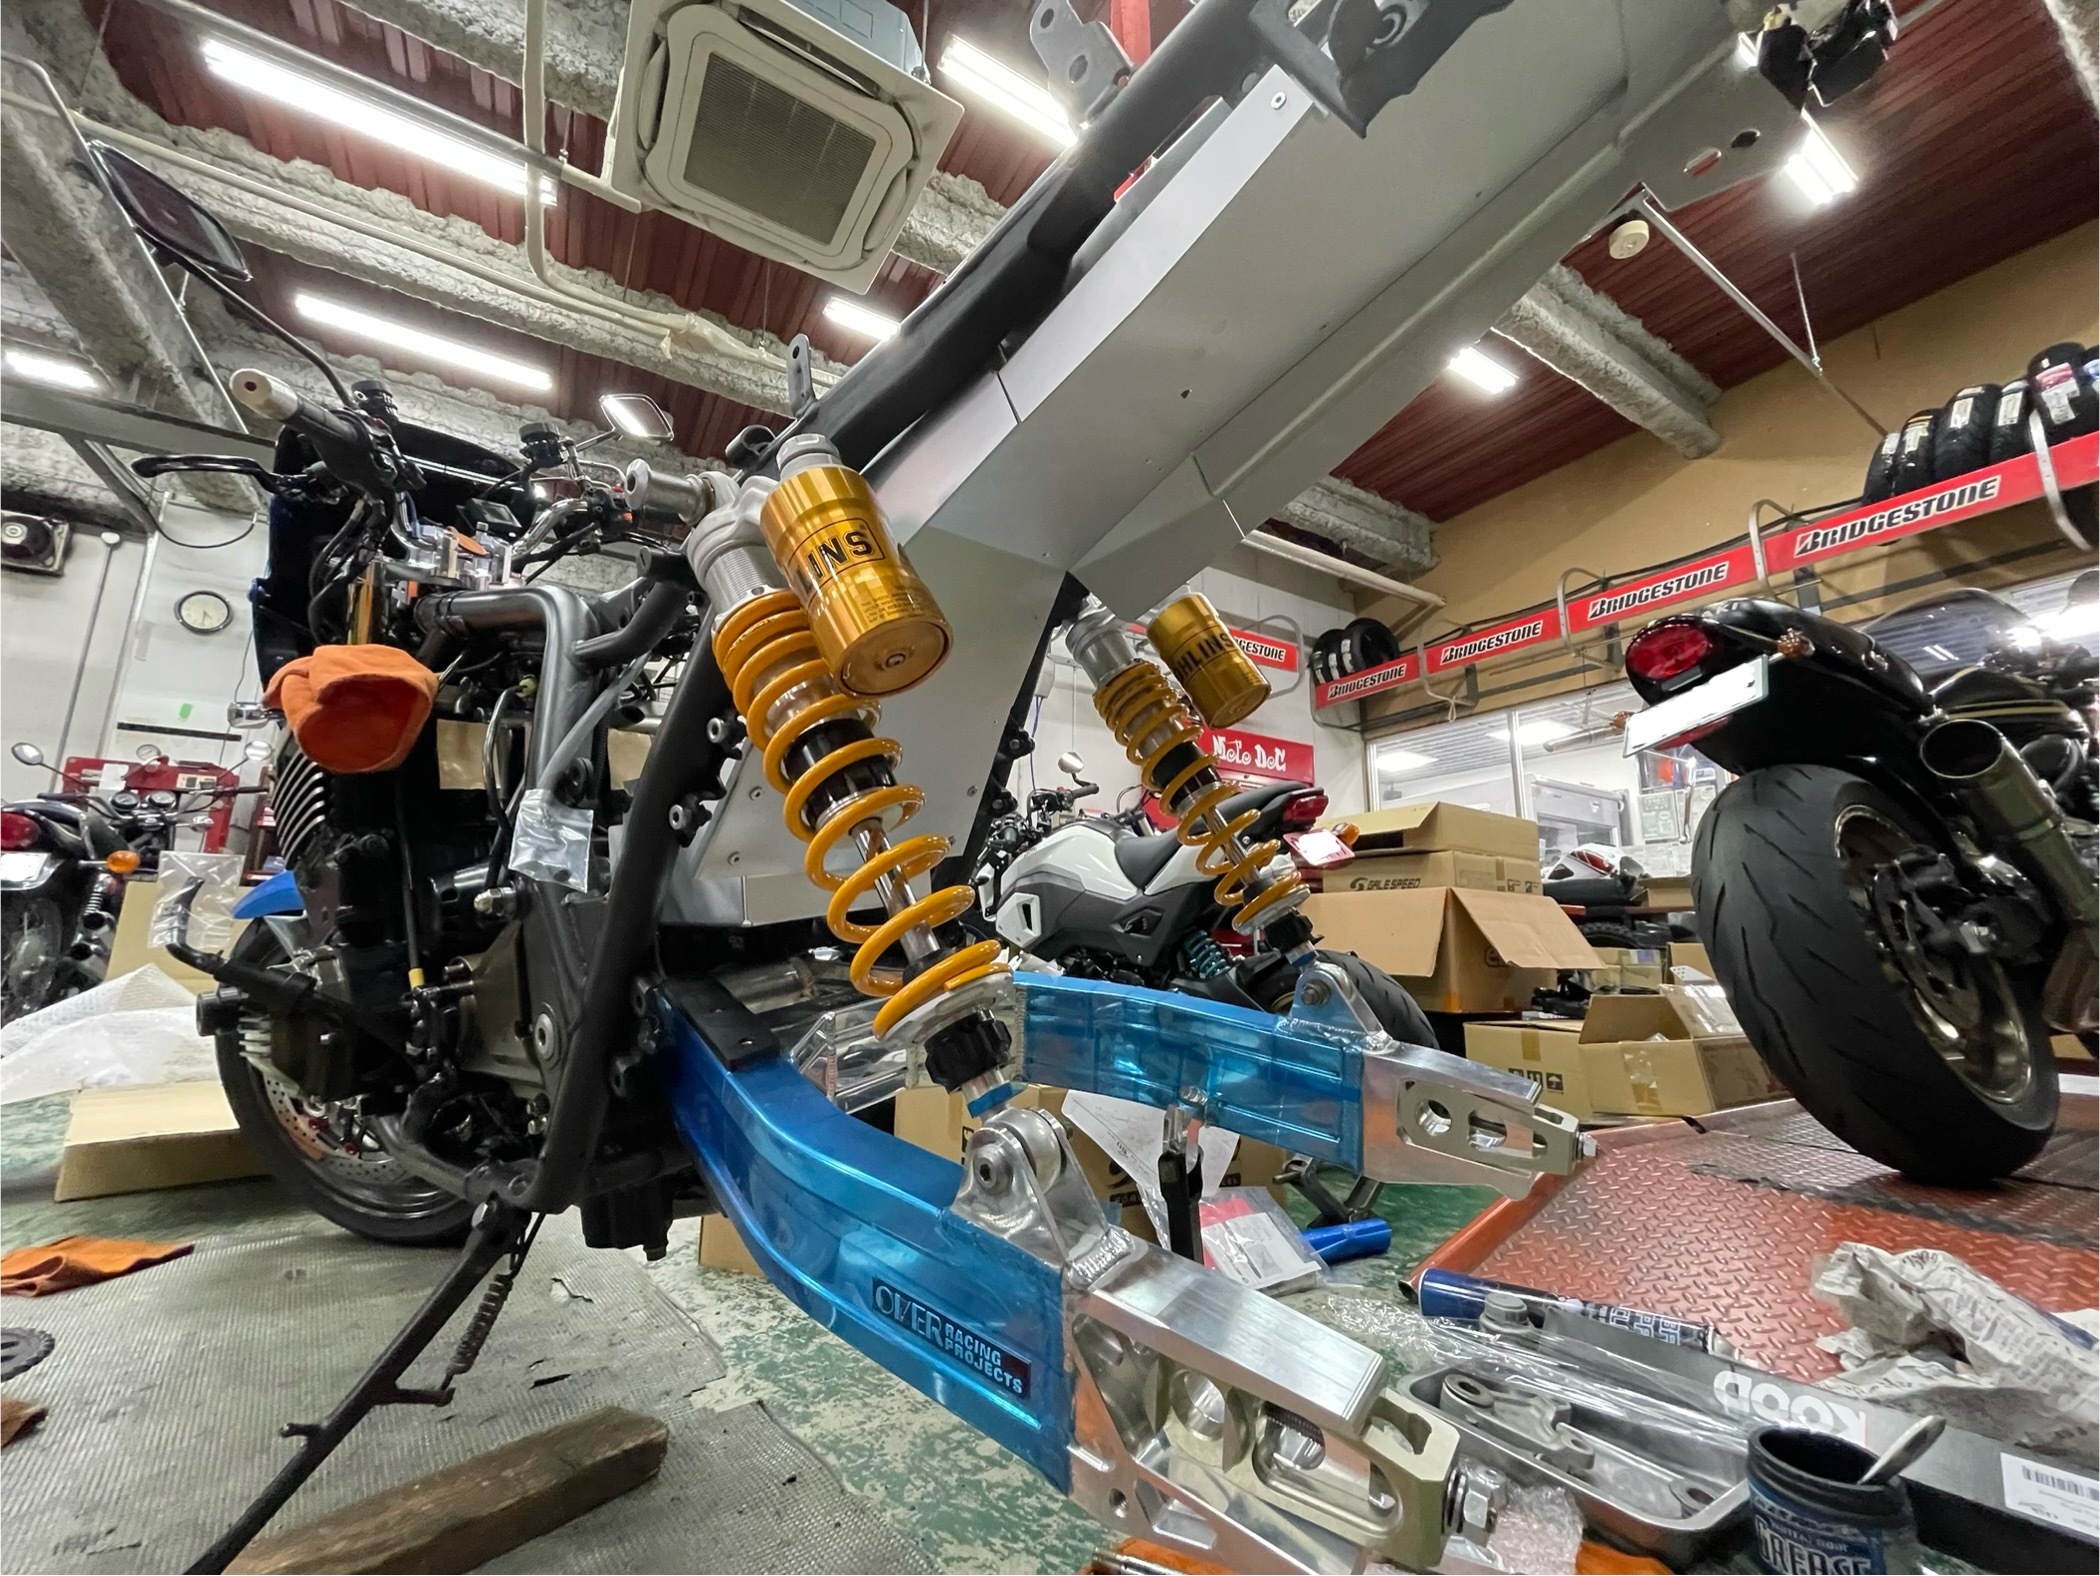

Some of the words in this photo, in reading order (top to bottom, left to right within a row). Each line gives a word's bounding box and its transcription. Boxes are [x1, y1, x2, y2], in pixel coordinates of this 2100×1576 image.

[1794, 475, 2000, 558] BRIDGESTONE
[1588, 562, 1728, 620] BRIDGESTONE
[1440, 621, 1542, 664] BRIDGESTONE
[1328, 664, 1406, 699] BRIDGESTONE
[875, 1285, 944, 1348] OVER
[945, 1322, 1001, 1367] RACING
[945, 1337, 1023, 1395] PROJECTS
[1713, 1370, 1867, 1448] KOOD
